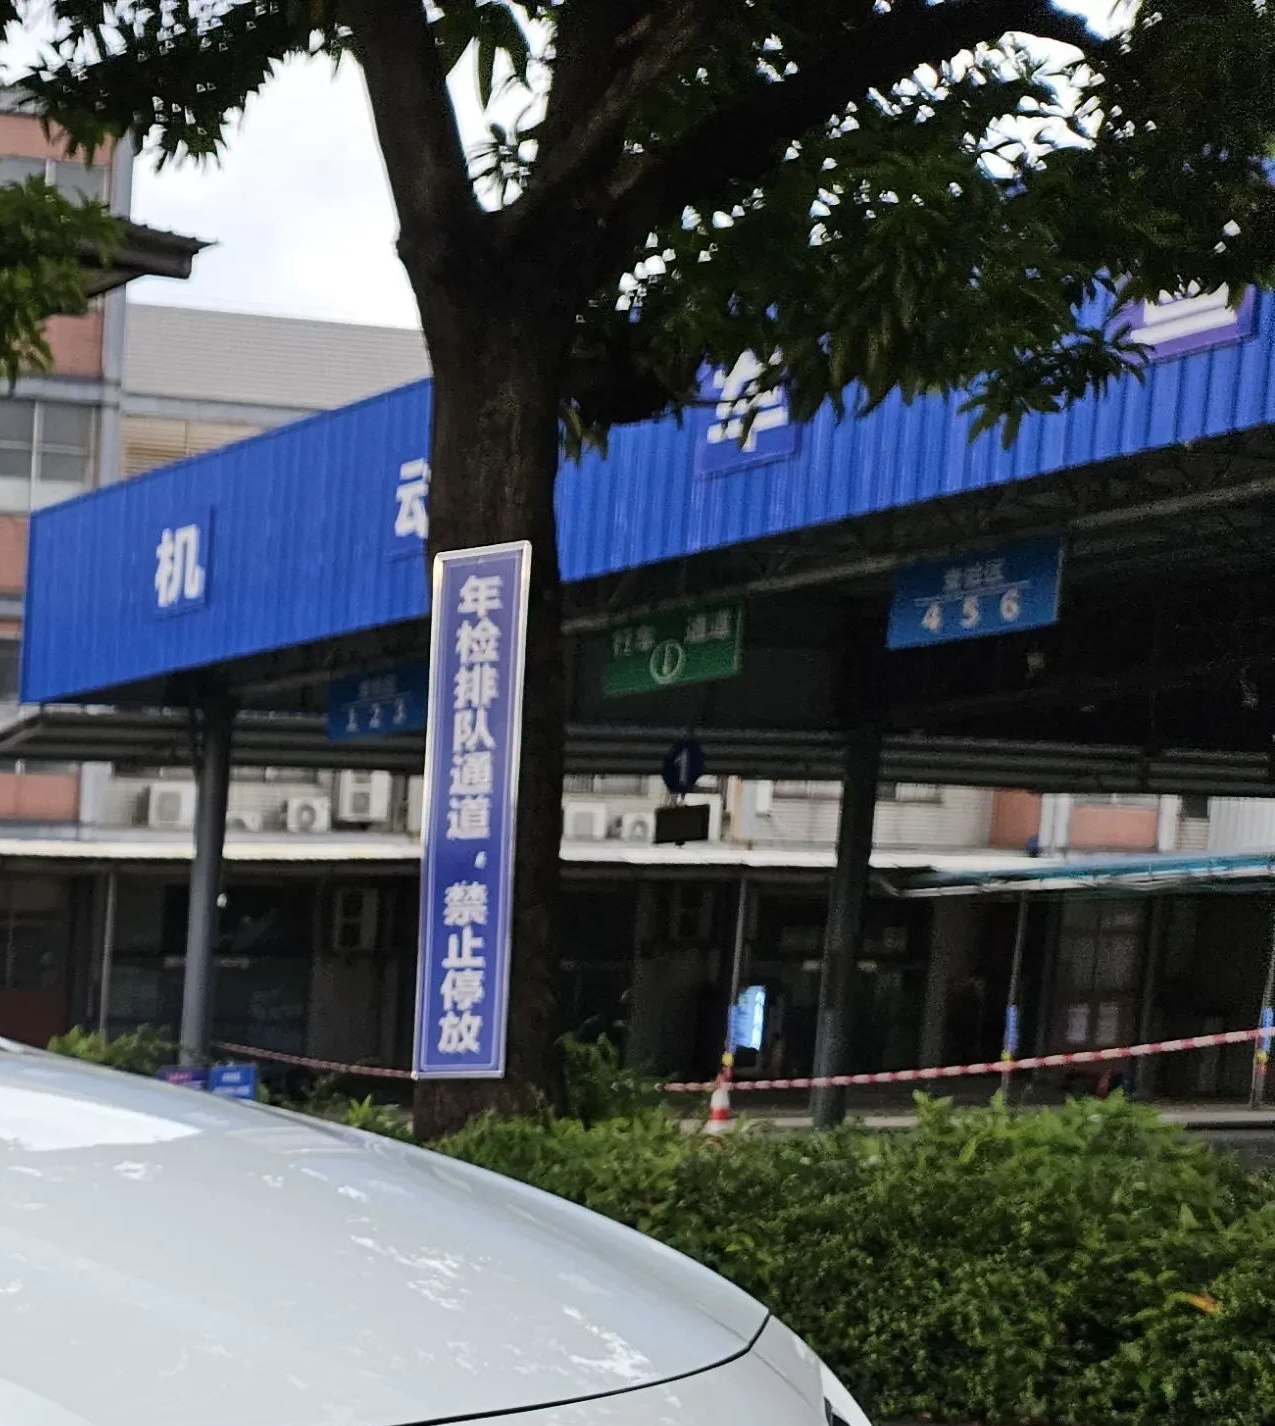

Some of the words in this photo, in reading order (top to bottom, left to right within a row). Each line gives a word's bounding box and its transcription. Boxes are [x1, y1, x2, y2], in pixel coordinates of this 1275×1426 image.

[154, 524, 205, 607] 机
[921, 602, 943, 632] 4
[960, 595, 980, 630] 5
[1000, 588, 1021, 622] 6
[673, 747, 689, 786] 1
